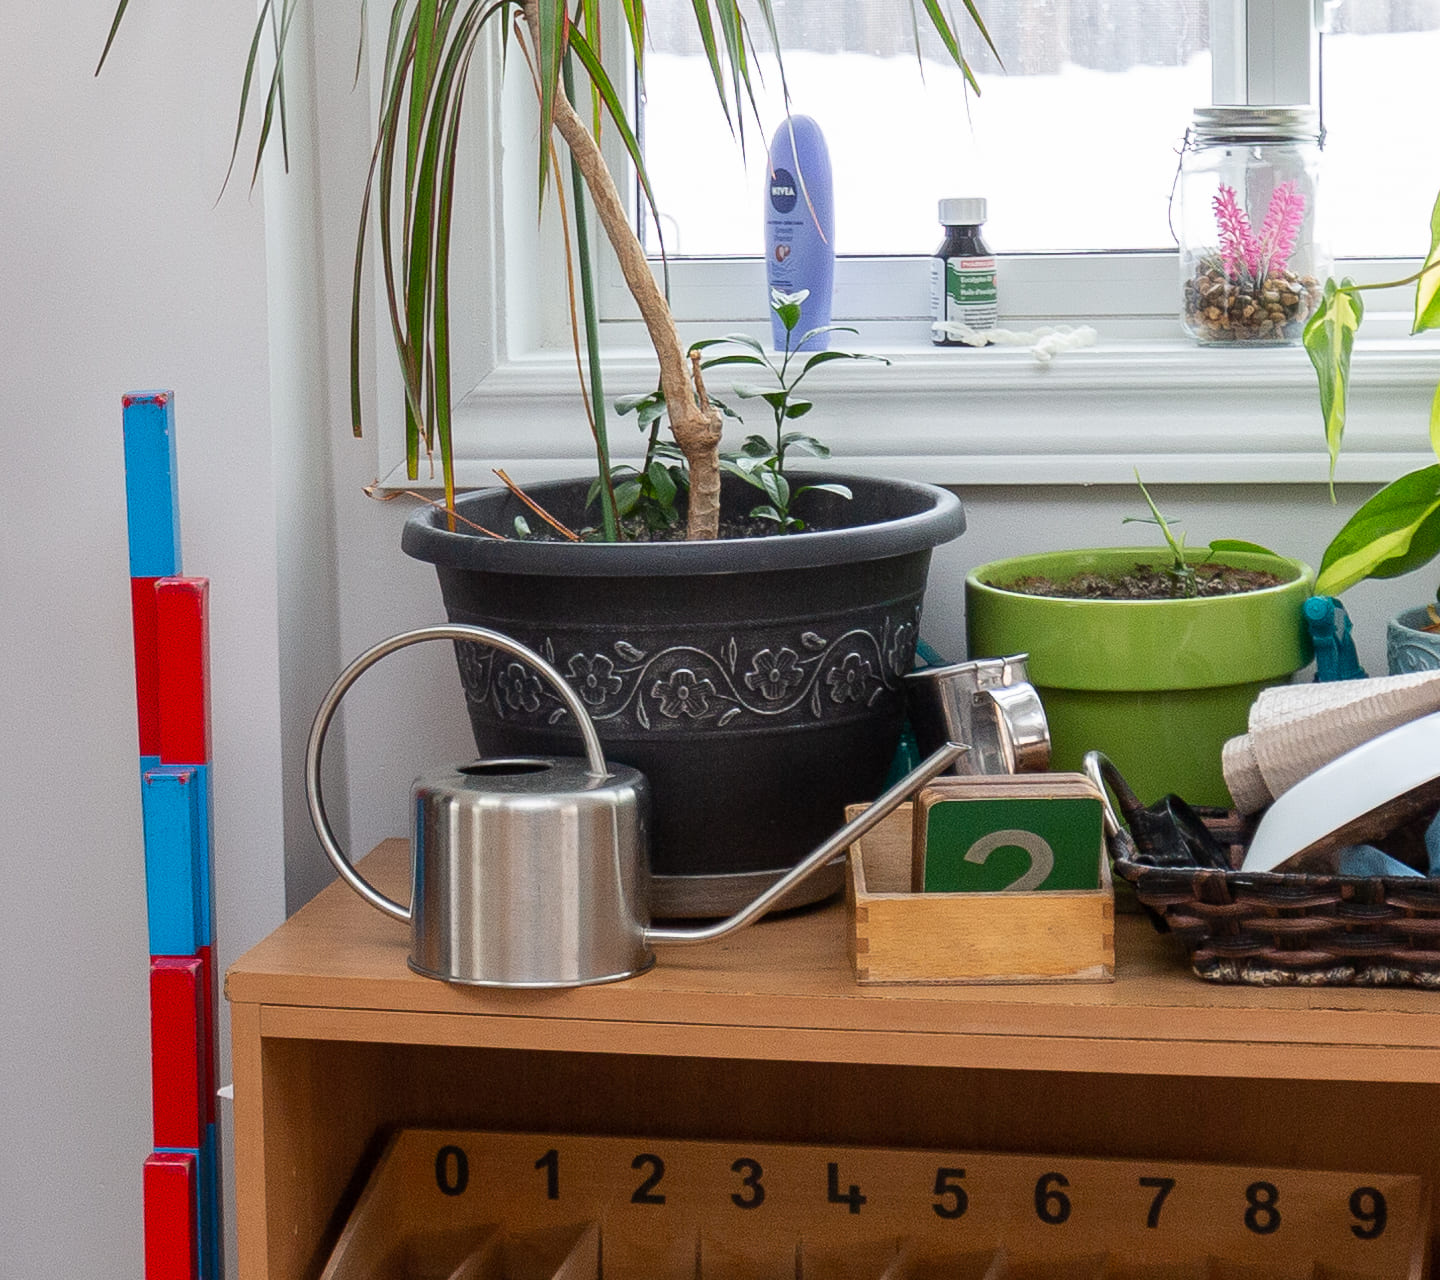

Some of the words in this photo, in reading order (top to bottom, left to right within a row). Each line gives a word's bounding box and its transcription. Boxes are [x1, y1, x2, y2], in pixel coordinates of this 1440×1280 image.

[963, 829, 1054, 891] 2
[435, 1145, 469, 1196] 0
[535, 1149, 559, 1200] 1
[631, 1154, 666, 1205] 2
[731, 1158, 765, 1210] 3
[827, 1162, 867, 1214] 4
[933, 1168, 968, 1219] 5
[1034, 1172, 1071, 1224] 6
[1139, 1177, 1176, 1228] 7
[1244, 1181, 1281, 1235] 8
[1349, 1188, 1387, 1240] 9
